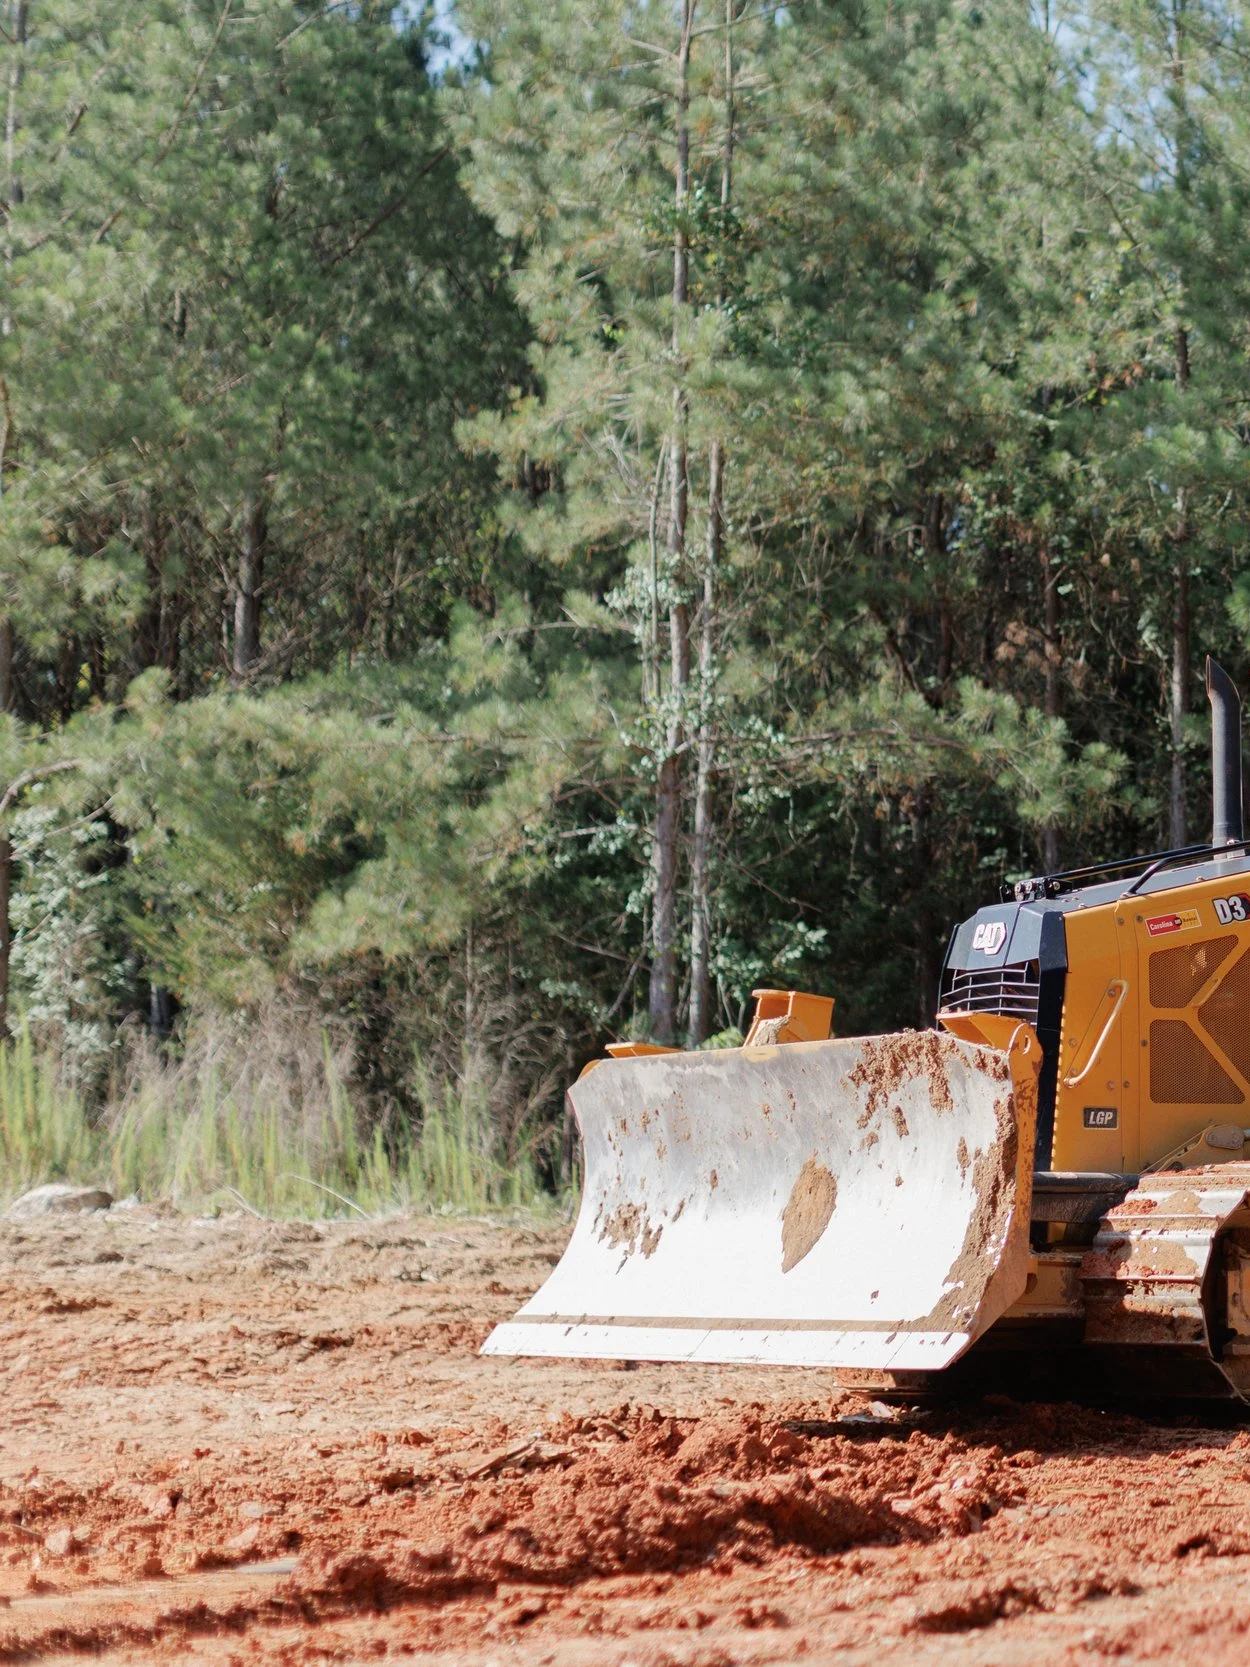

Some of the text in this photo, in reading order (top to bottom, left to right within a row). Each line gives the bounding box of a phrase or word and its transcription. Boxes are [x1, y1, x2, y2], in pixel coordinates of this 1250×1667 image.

[1213, 895, 1246, 924] D3
[1149, 920, 1174, 931] Carolina
[1088, 1111, 1114, 1125] LGP
